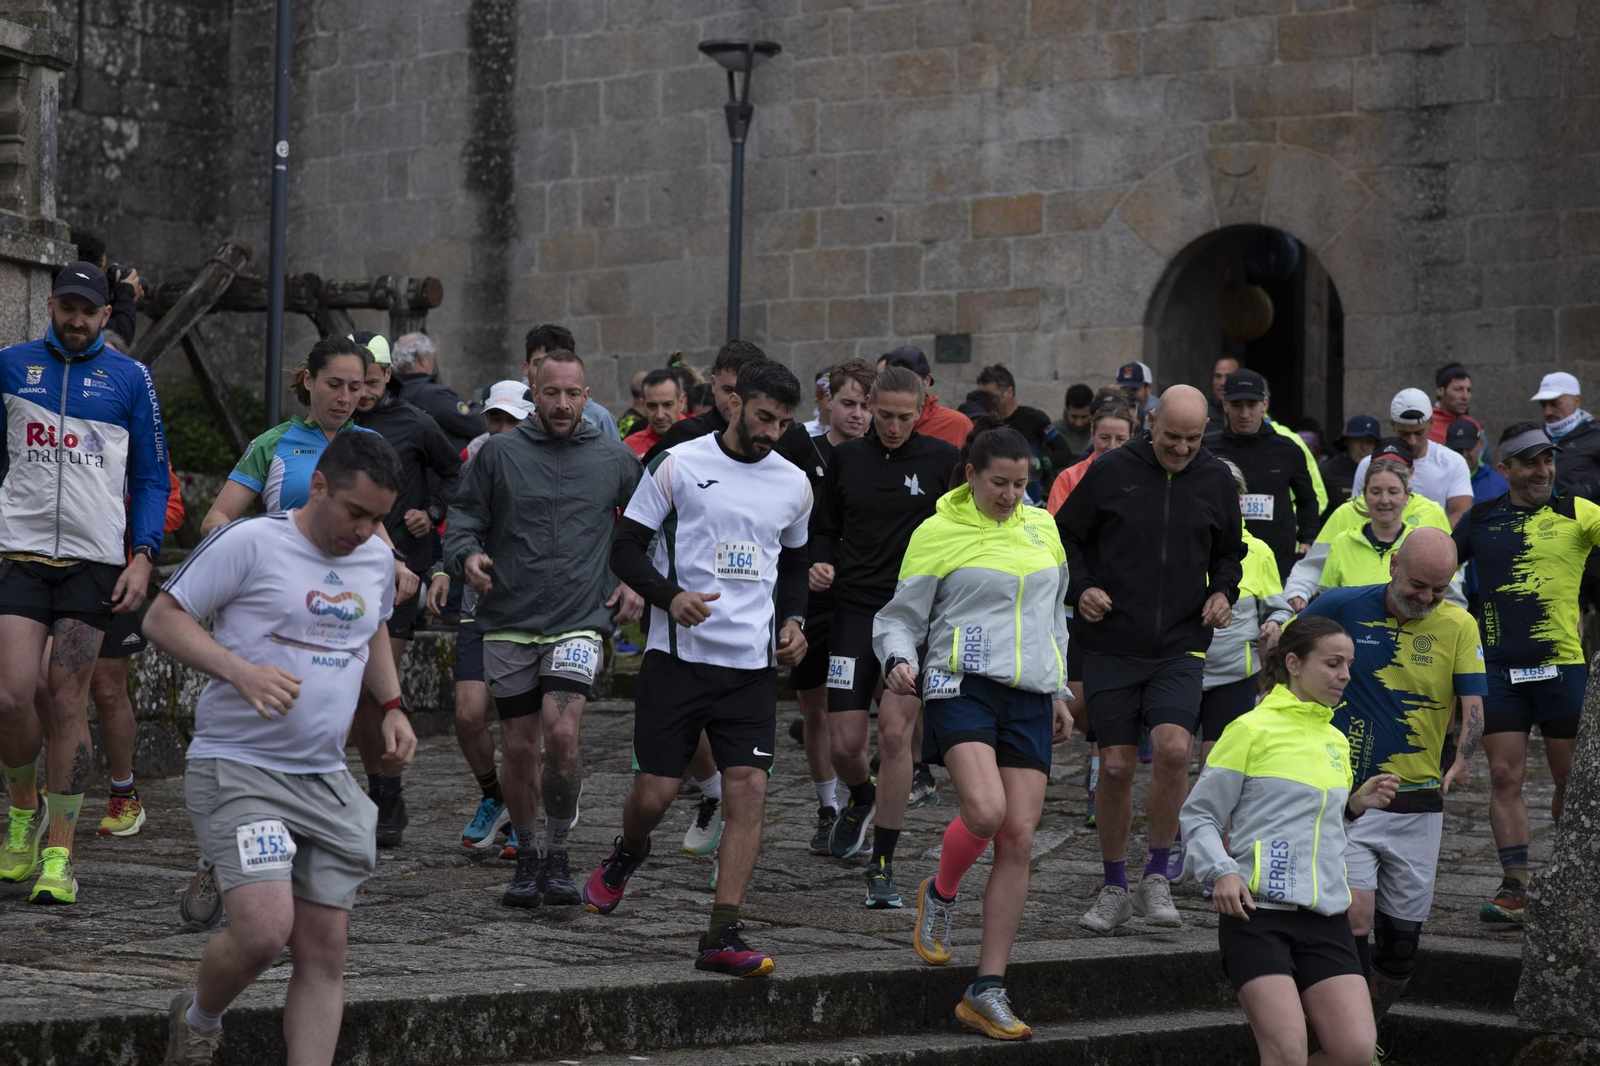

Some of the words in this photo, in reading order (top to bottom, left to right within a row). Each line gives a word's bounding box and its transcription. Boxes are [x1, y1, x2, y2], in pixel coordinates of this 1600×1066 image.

[135, 361, 153, 389] SANTA
[148, 389, 161, 426] OLALLA
[26, 422, 79, 448] Rio
[154, 432, 164, 462] LUBRE
[26, 448, 104, 468] natura
[1247, 502, 1264, 513] 181
[728, 552, 753, 568] 164
[1484, 602, 1496, 646] SERRES
[563, 648, 589, 664] 163
[1411, 654, 1434, 664] SERRES
[1521, 666, 1545, 676] 168
[926, 674, 952, 690] 157
[256, 835, 287, 855] 153
[1267, 840, 1290, 900] SERRES
